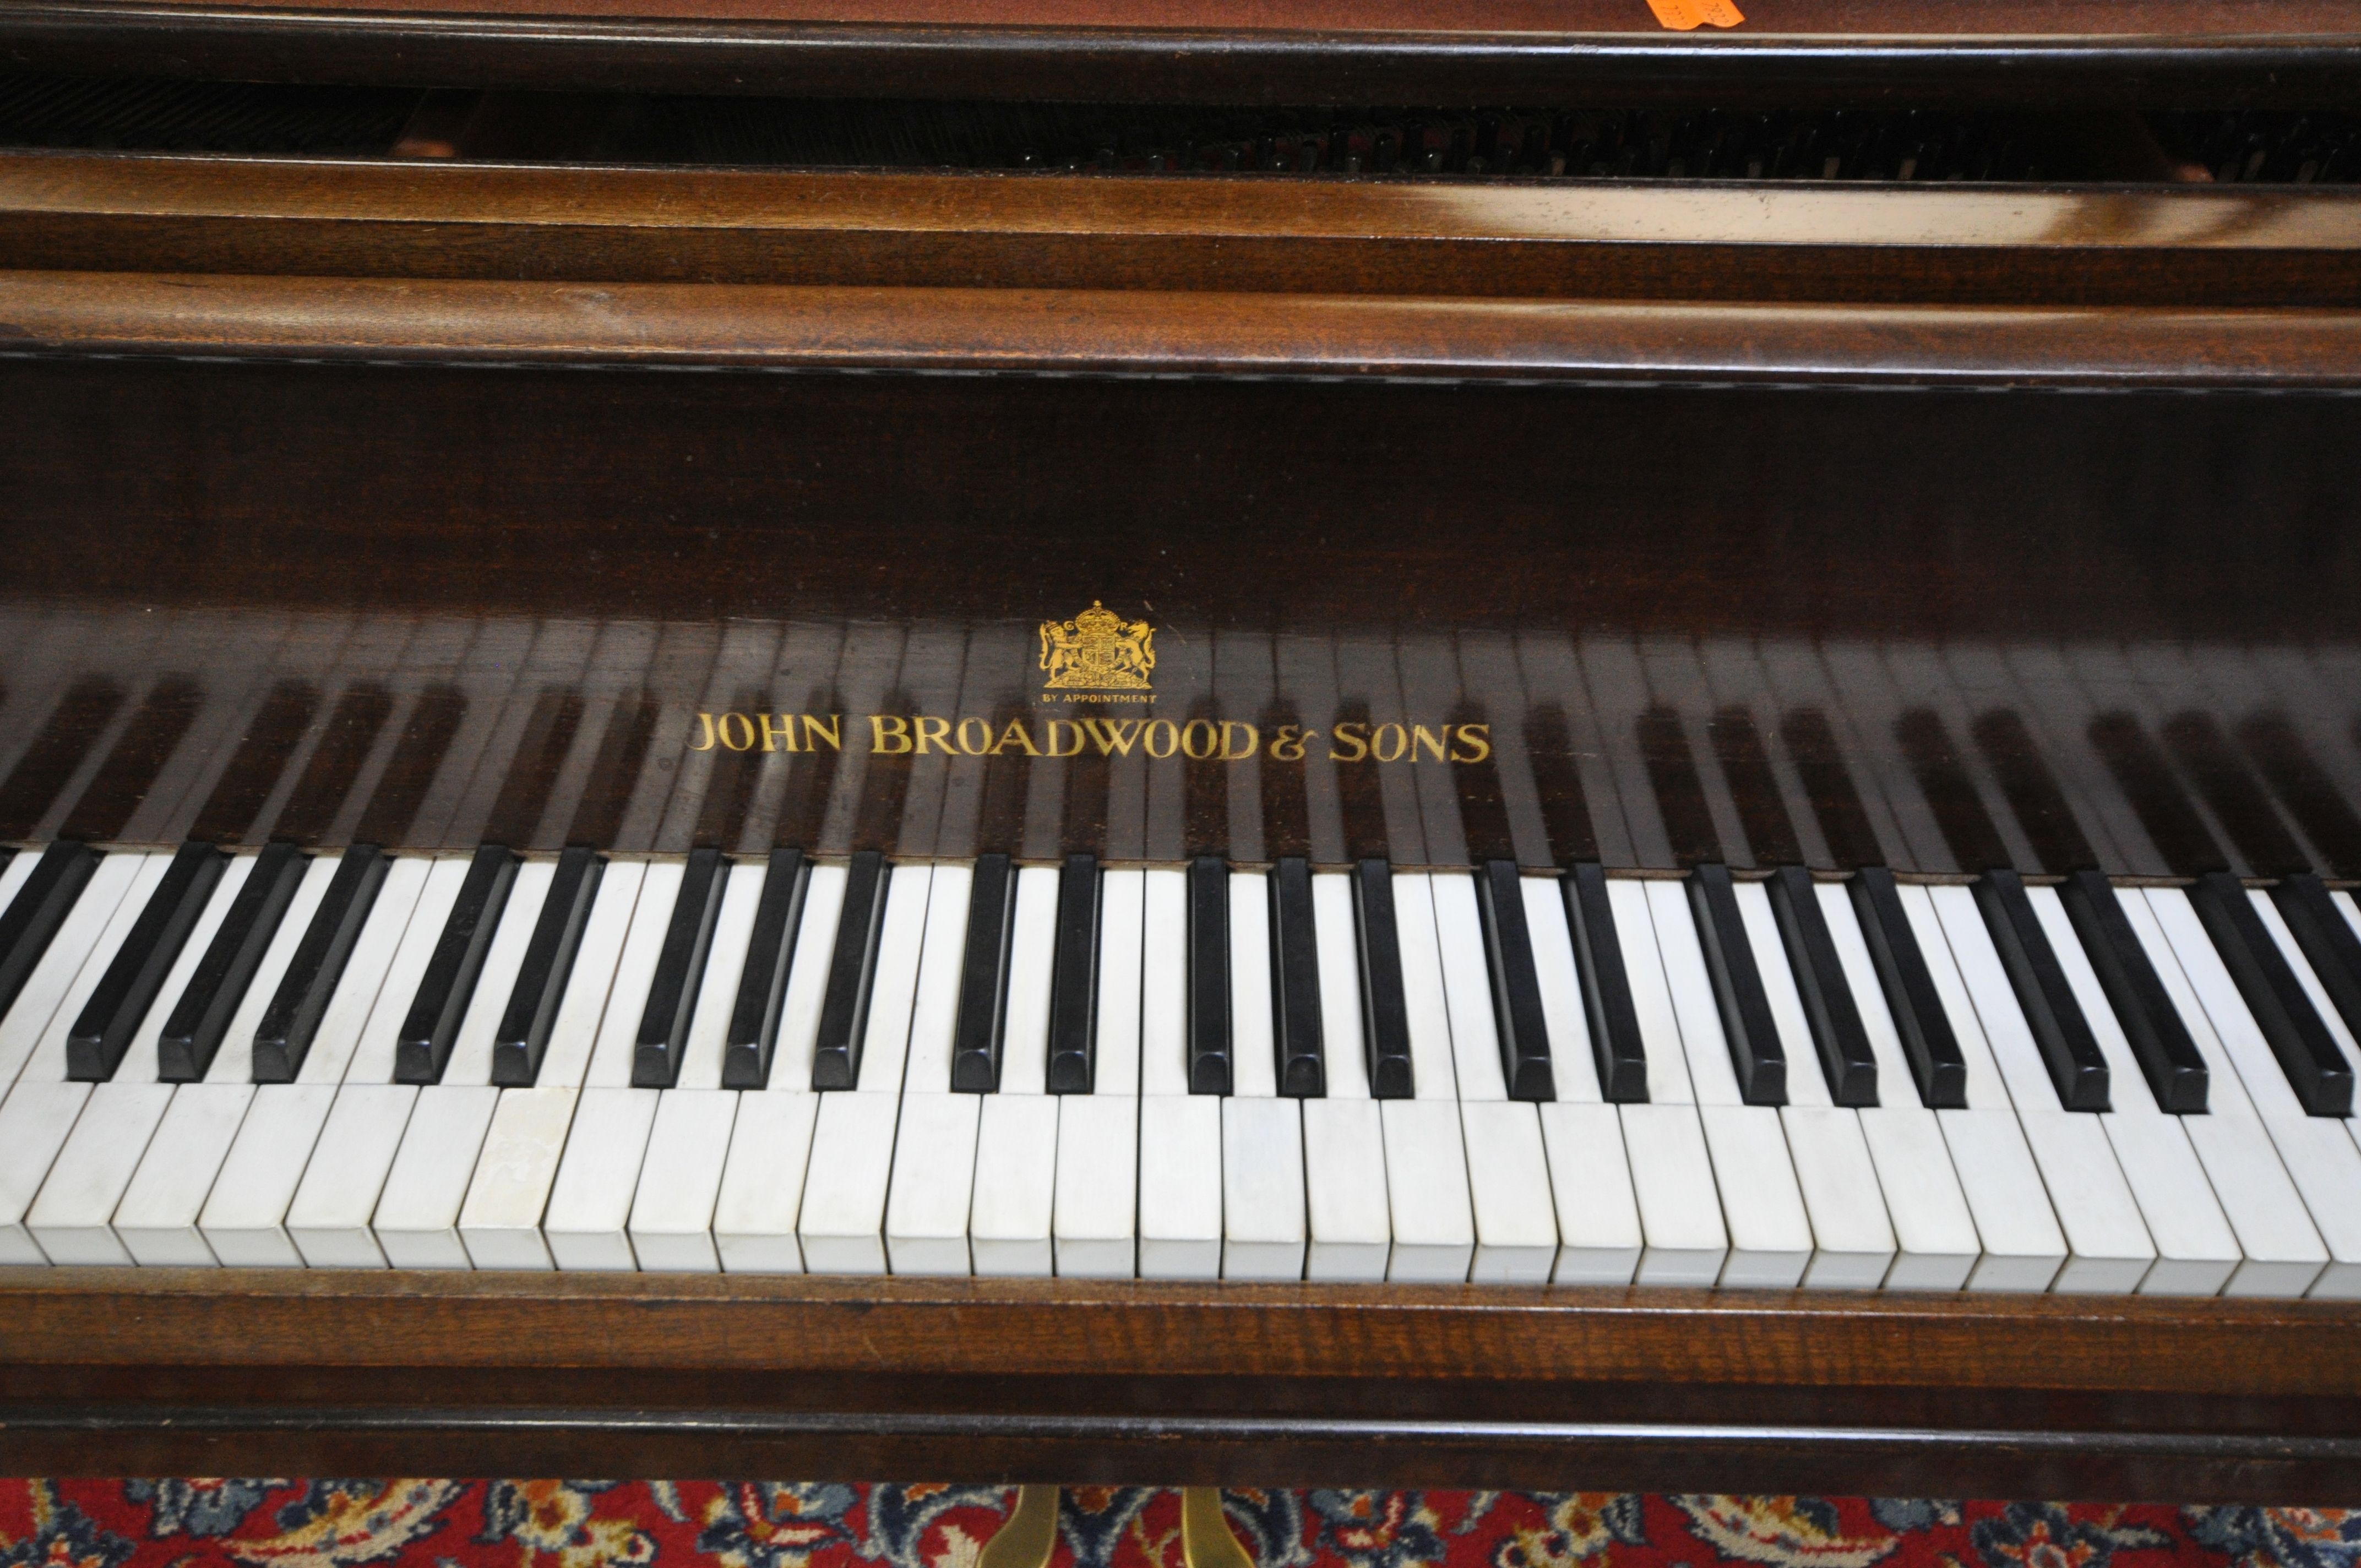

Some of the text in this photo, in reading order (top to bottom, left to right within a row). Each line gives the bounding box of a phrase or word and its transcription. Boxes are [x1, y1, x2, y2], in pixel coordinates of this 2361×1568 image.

[1120, 622, 1128, 631] R
[1042, 693, 1157, 704] BY APPOINTMENT
[684, 712, 1490, 763] JOHN BROADWOOD & SONS
